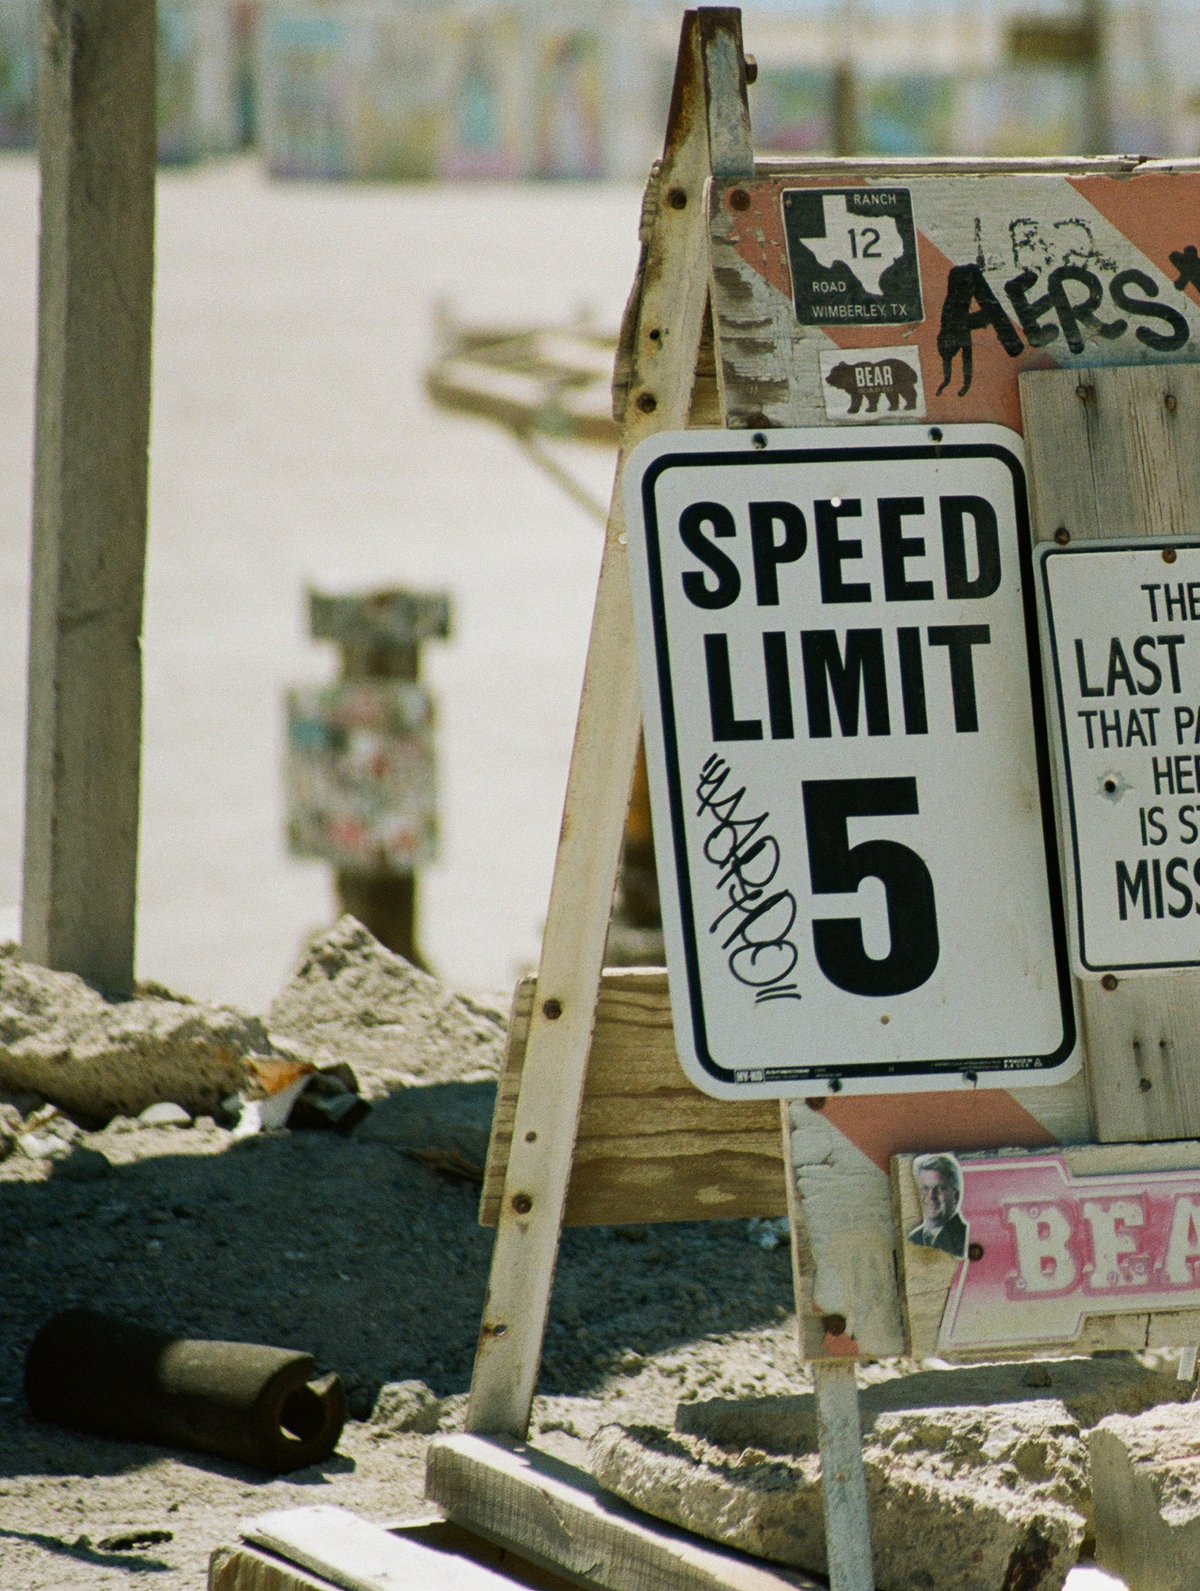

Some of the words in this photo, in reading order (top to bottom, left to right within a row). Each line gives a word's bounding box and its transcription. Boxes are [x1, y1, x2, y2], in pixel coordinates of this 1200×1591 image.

[853, 193, 897, 205] RANCH
[847, 227, 882, 258] 12
[812, 281, 847, 292] ROAD
[812, 304, 887, 318] WIMBERLEY,
[890, 303, 907, 315] TX
[855, 366, 893, 387] BEAR
[679, 495, 1001, 609] SPEED
[704, 624, 991, 742] LIMIT
[1074, 634, 1186, 697] LAST
[1078, 707, 1160, 749] THAT
[1139, 806, 1168, 846] IS
[801, 776, 940, 997] 5
